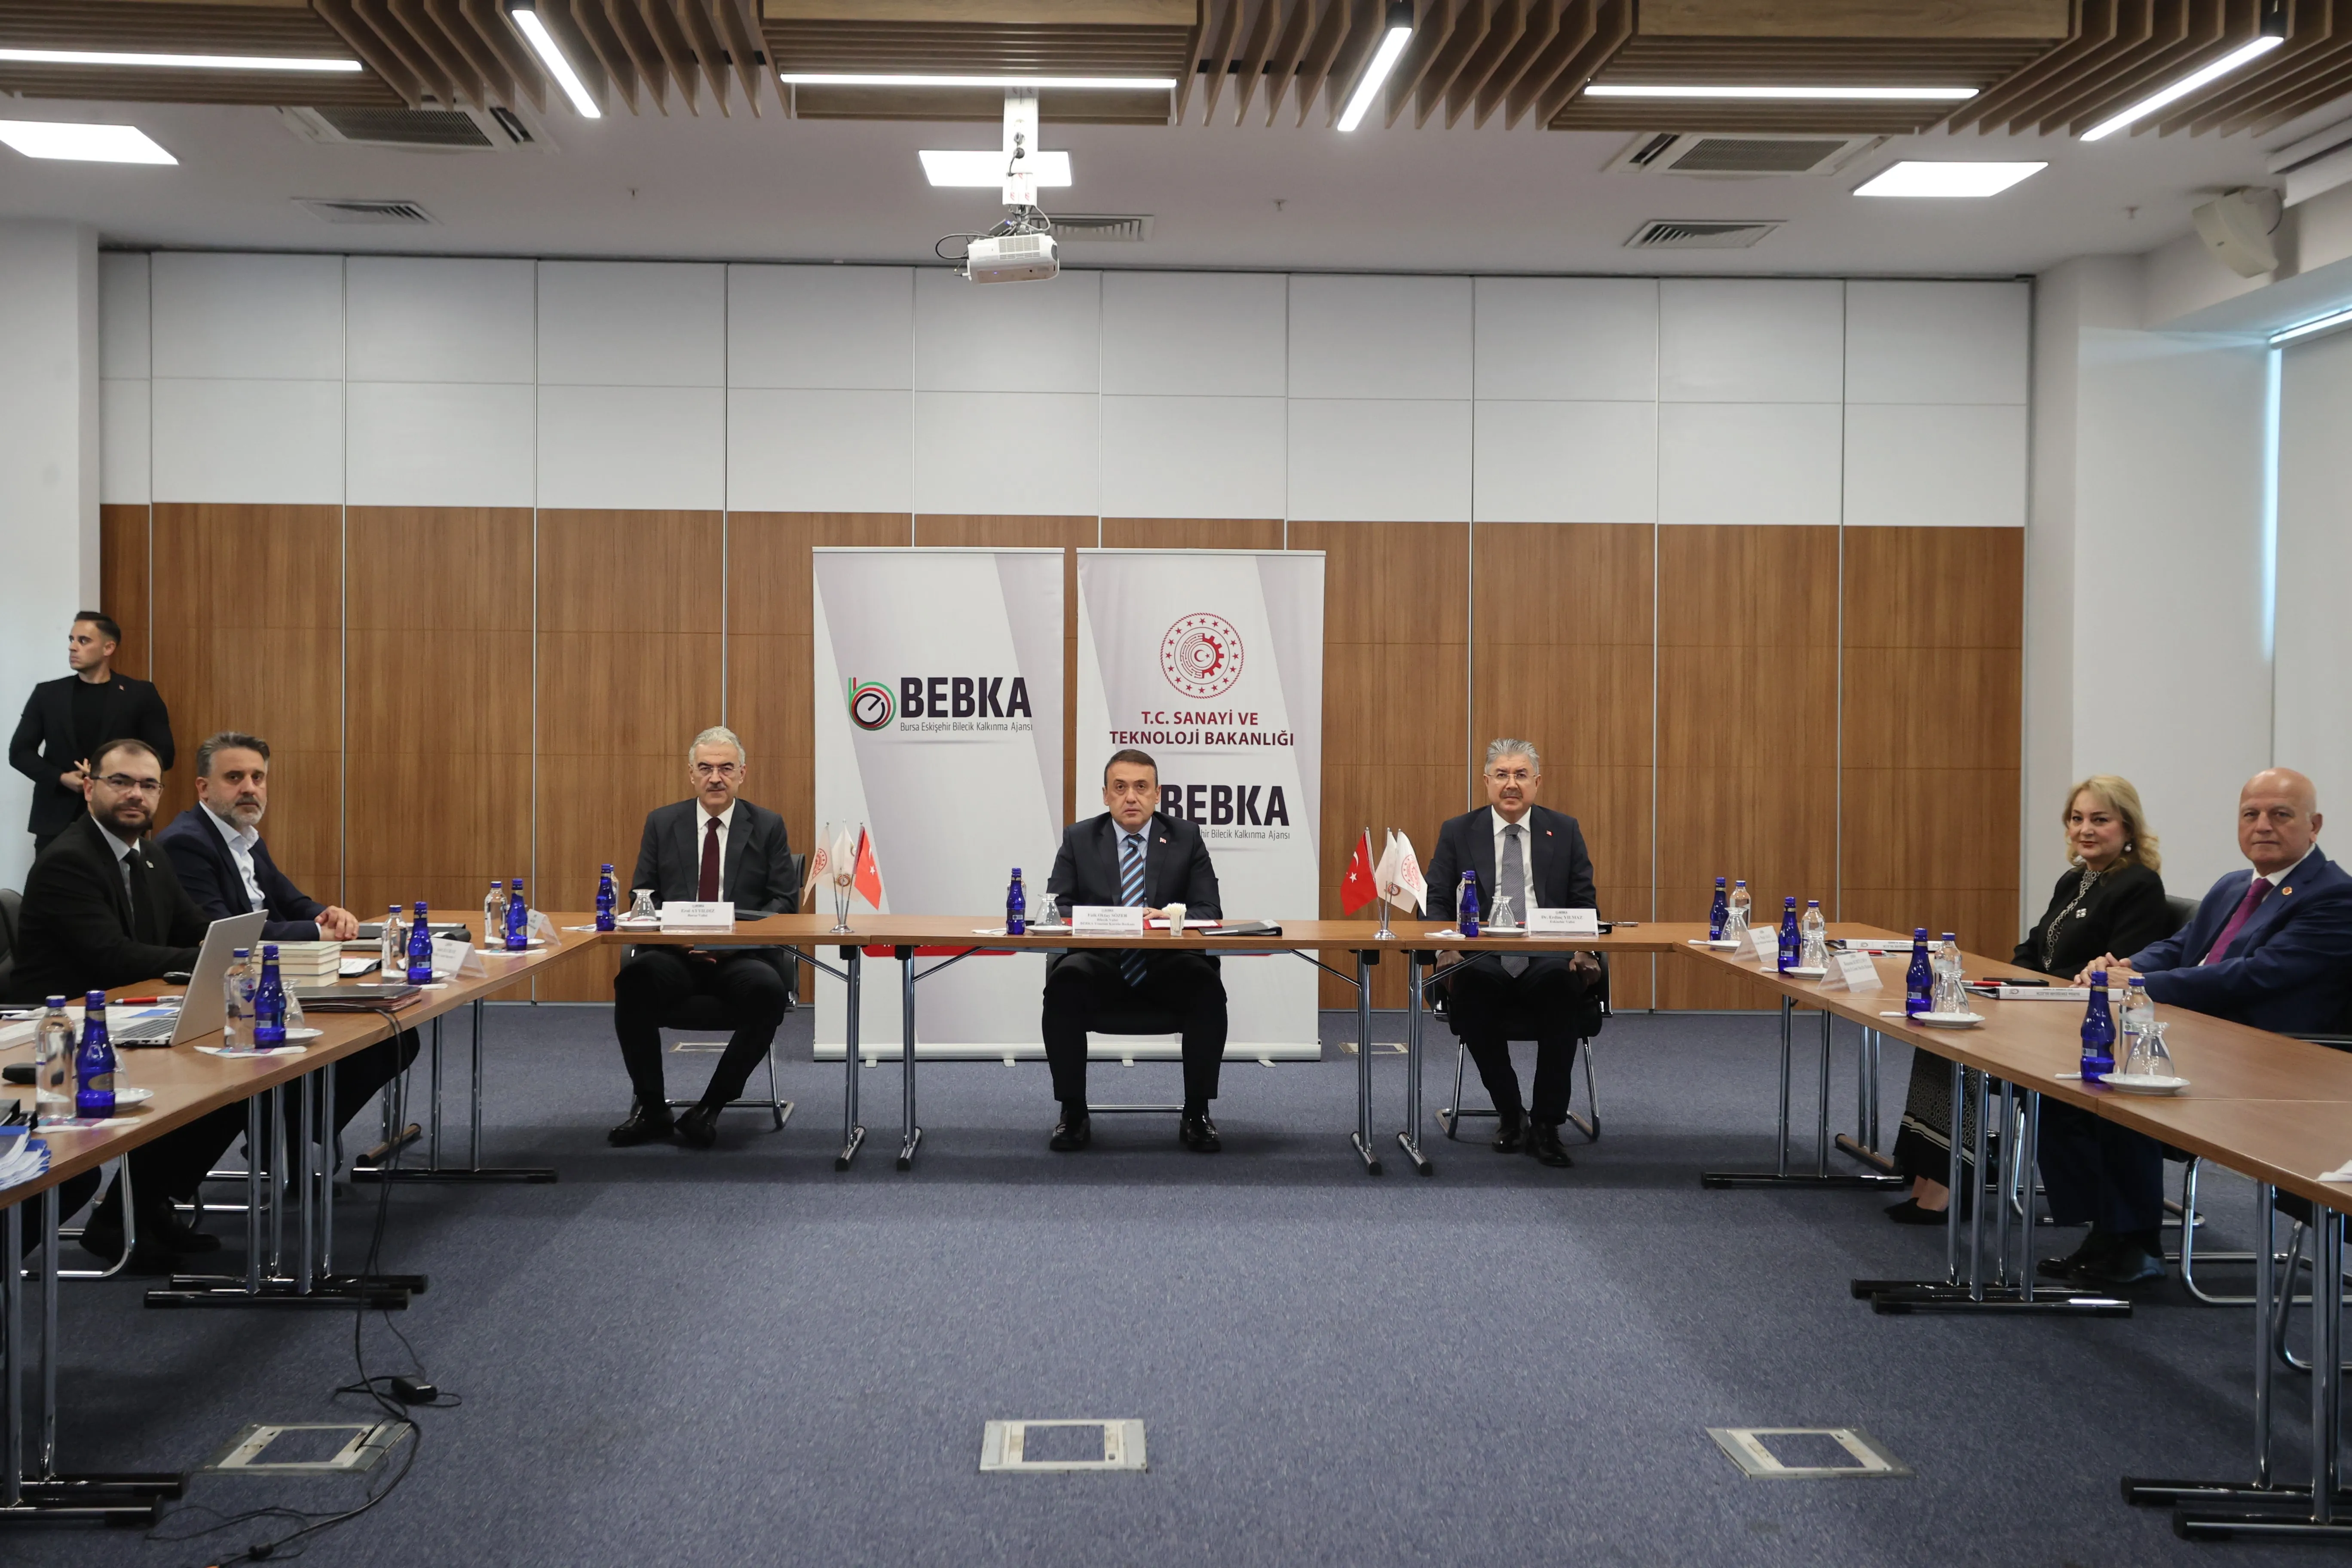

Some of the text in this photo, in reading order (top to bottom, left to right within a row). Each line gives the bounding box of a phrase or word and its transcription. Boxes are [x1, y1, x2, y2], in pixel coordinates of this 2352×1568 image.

[900, 677, 1032, 718] BEBKA
[1141, 709, 1259, 726] T.C. SANAYİ VE
[900, 722, 1033, 733] Bursa Eskişehir Bilecik Kalkınma Ajansı
[1109, 729, 1294, 746] TEKNOLOJİ BAKANLIĞI
[1161, 784, 1289, 826] BEBKA
[1211, 829, 1232, 838] Bilecik
[1235, 830, 1265, 839] Kalkınma
[1268, 830, 1290, 841] Ajansı
